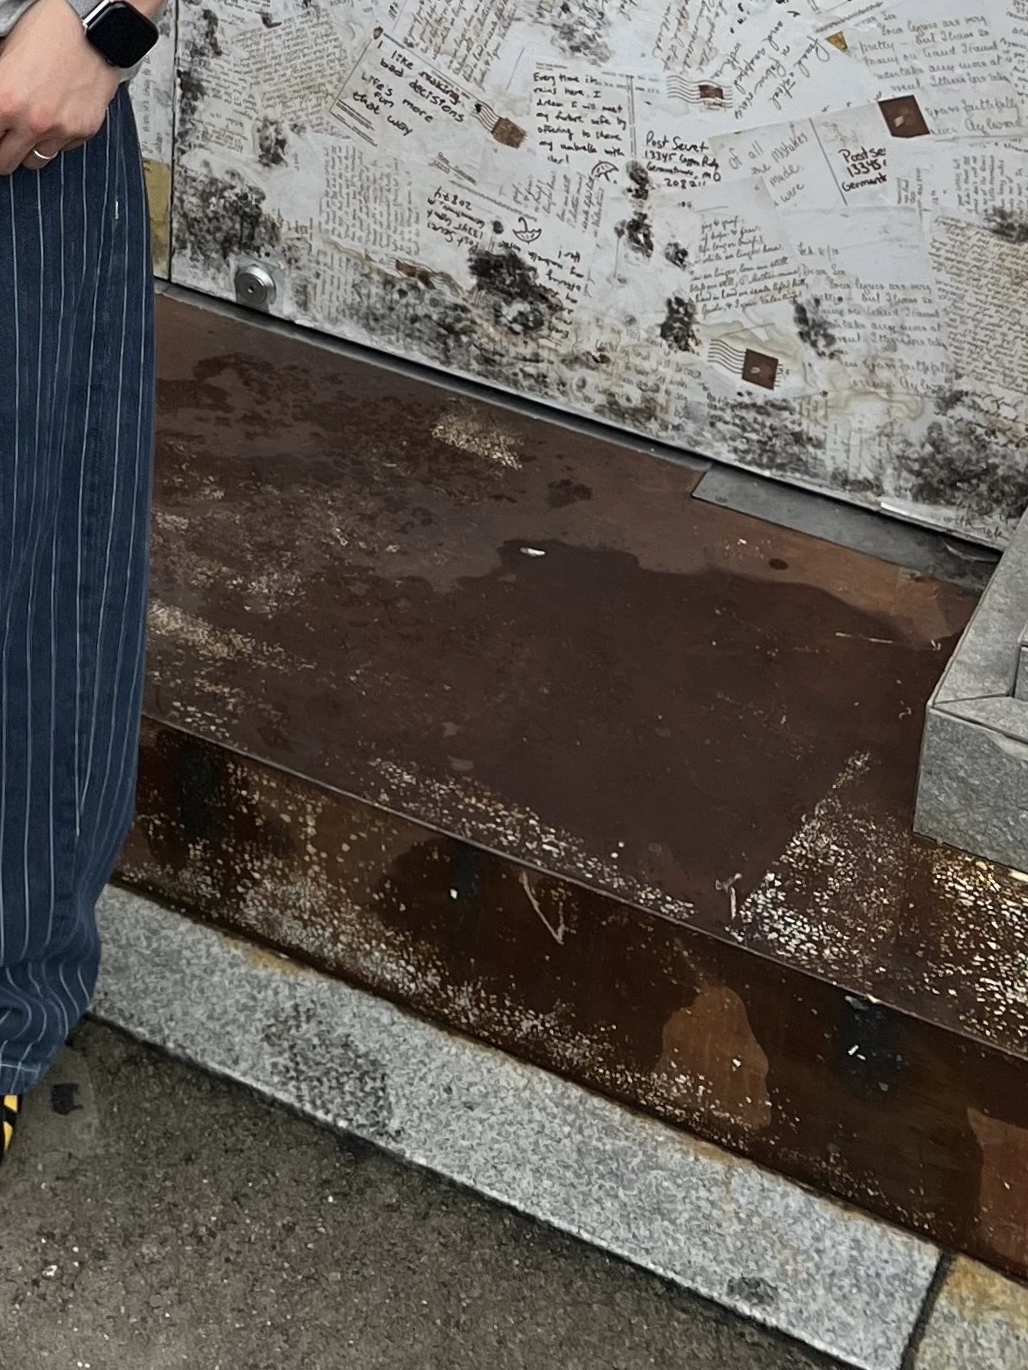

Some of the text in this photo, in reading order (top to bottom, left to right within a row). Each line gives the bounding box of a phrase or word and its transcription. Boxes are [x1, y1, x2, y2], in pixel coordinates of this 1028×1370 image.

[391, 50, 413, 70] like
[533, 72, 556, 86] Every
[380, 58, 464, 123] bad decisions
[352, 91, 413, 136] that way
[402, 99, 433, 123] more
[646, 130, 670, 149] Post
[645, 150, 677, 163] 13345
